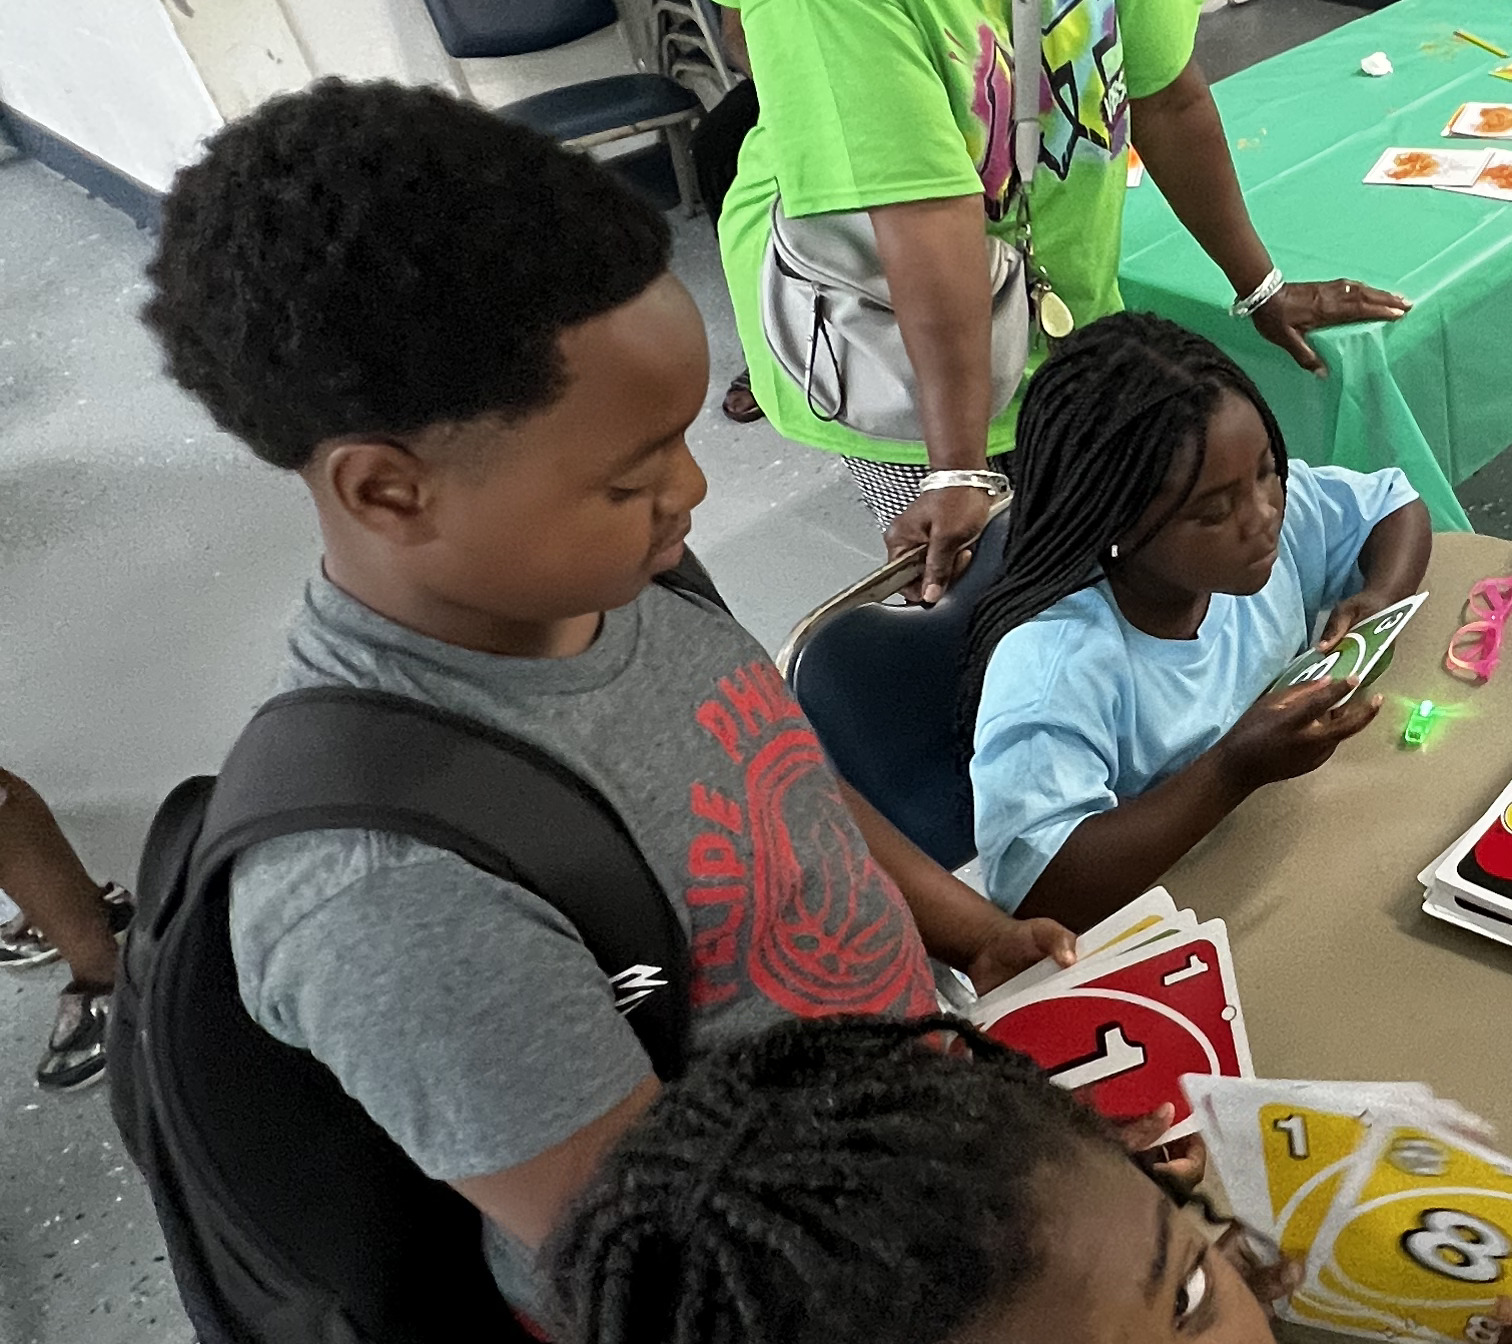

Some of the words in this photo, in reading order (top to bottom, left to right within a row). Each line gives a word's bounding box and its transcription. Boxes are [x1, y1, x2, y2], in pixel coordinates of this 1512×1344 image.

[1163, 954, 1209, 986] 1
[1047, 1025, 1146, 1091] 1
[1274, 1113, 1309, 1159] 1
